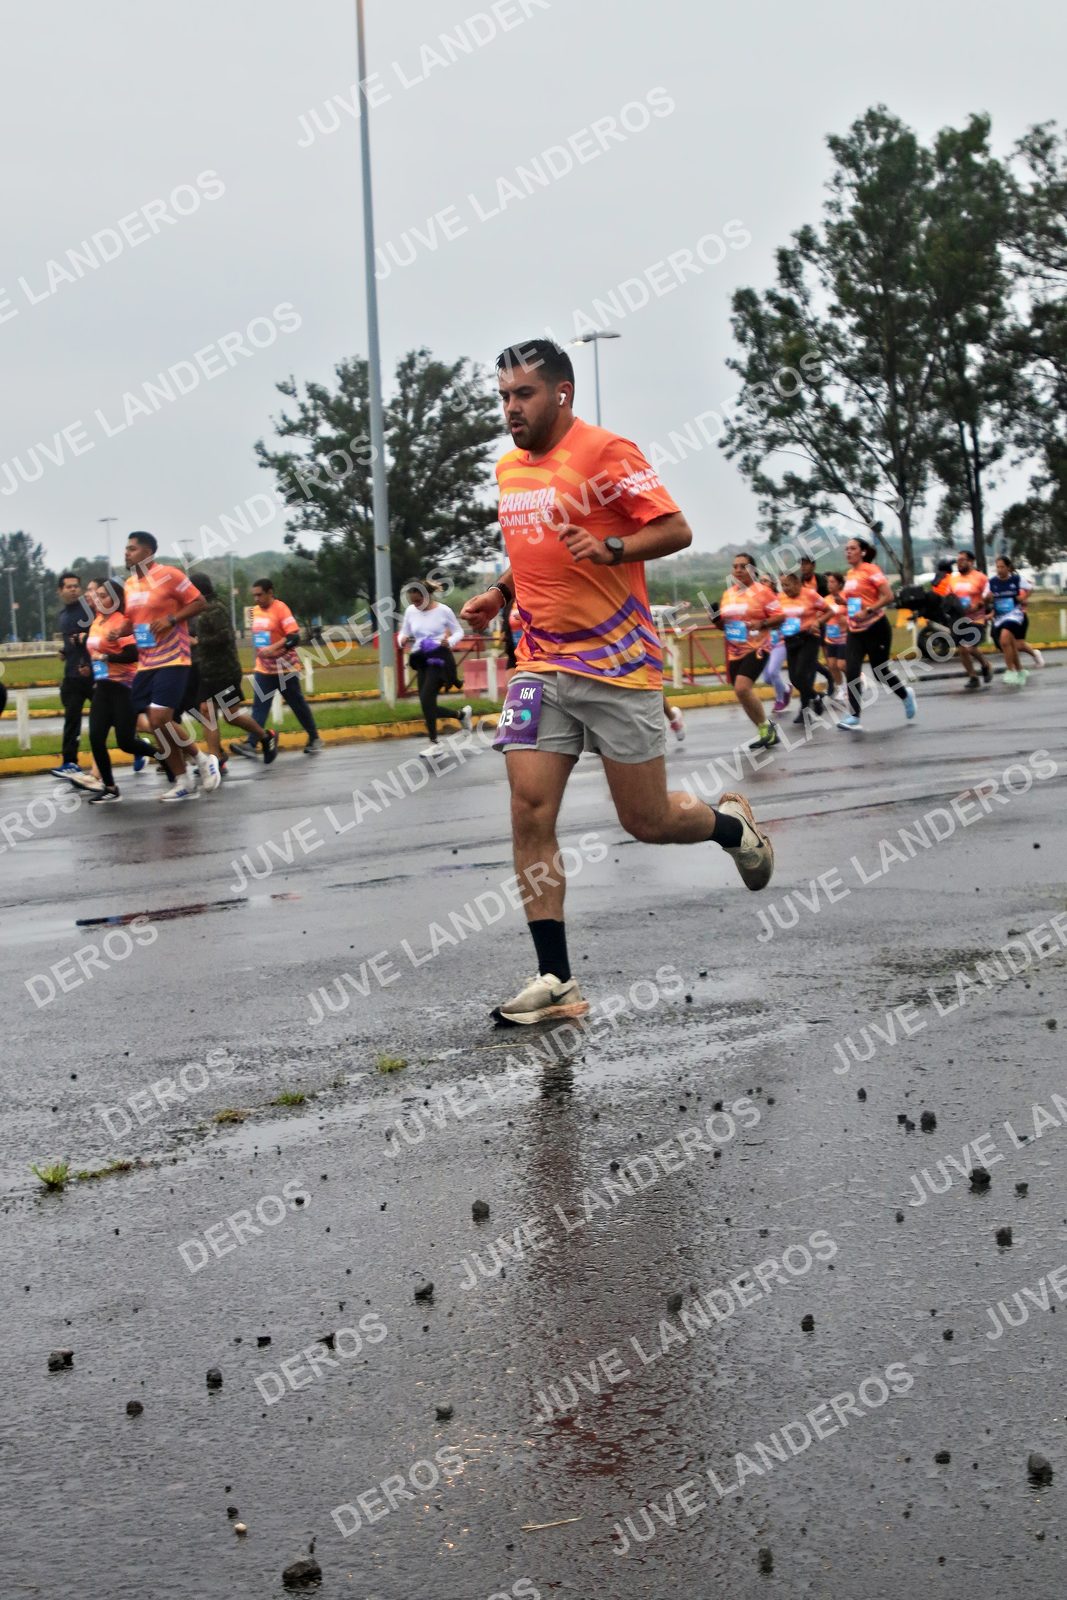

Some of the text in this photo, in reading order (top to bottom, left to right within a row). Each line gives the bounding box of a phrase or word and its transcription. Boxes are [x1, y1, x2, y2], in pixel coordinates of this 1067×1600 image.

[500, 487, 556, 513] CARRERA
[500, 512, 540, 527] OMNILIFE
[520, 687, 536, 700] 15K
